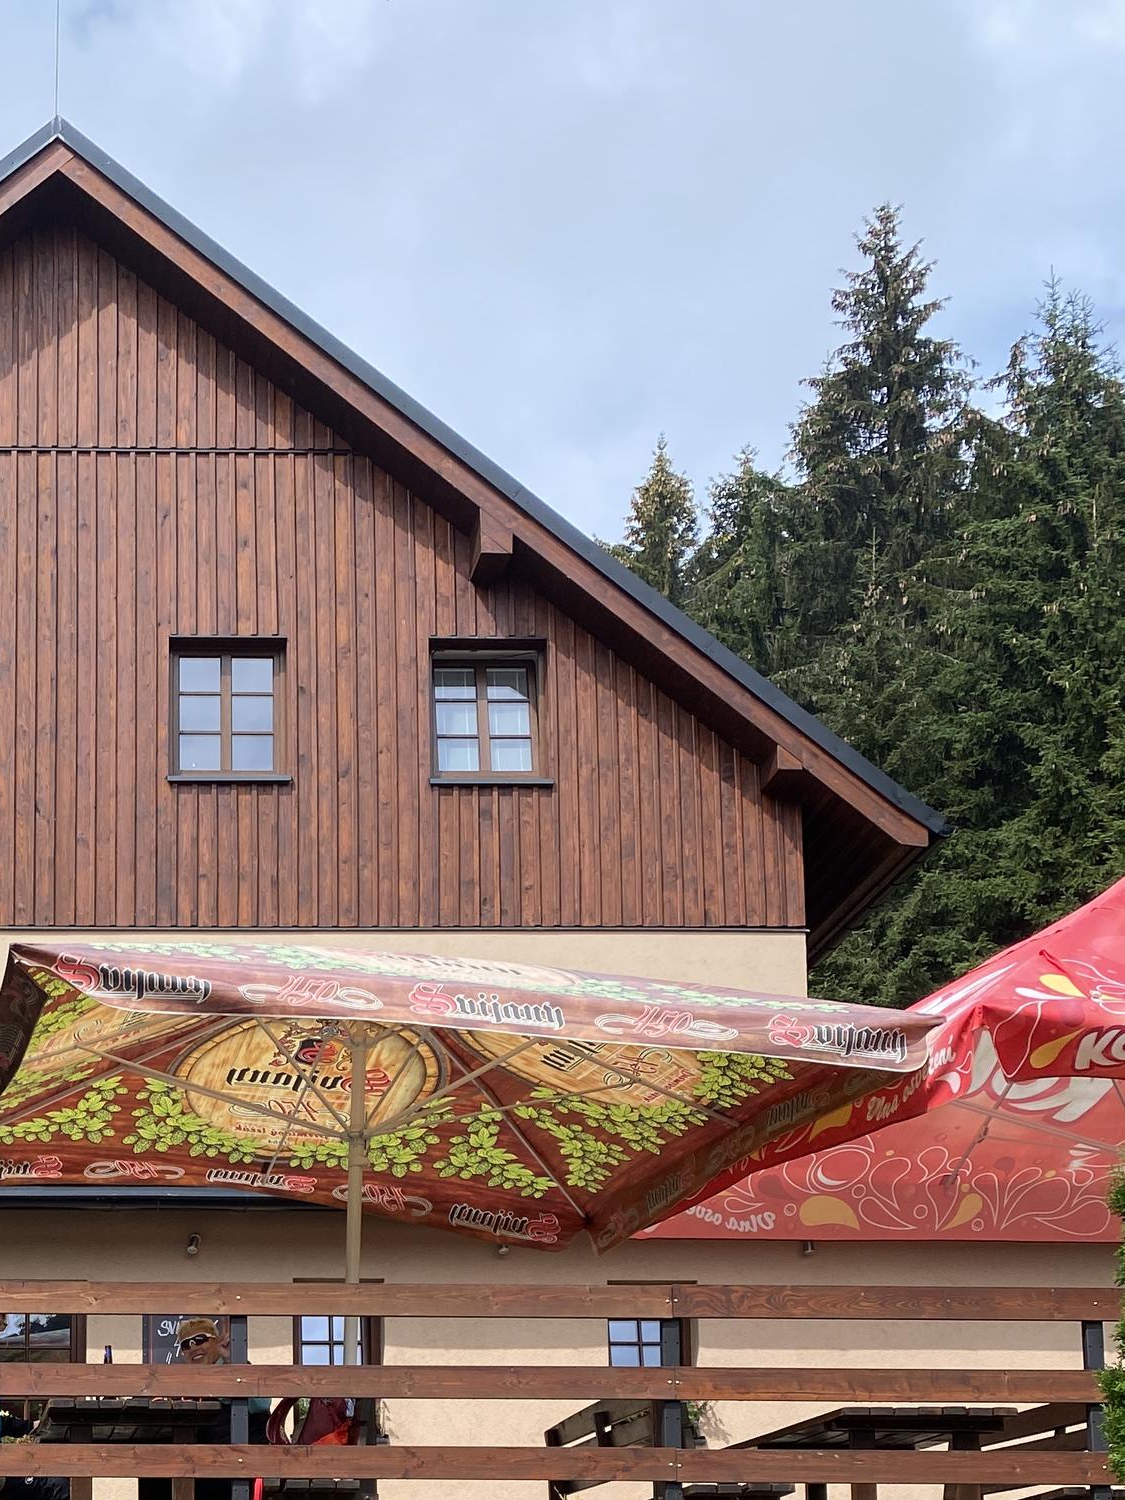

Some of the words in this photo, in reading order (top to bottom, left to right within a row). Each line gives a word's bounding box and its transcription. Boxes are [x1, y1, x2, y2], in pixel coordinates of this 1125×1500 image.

[51, 952, 211, 1004] Svijany
[408, 982, 566, 1030] Svijany
[768, 1015, 908, 1062] Svijany
